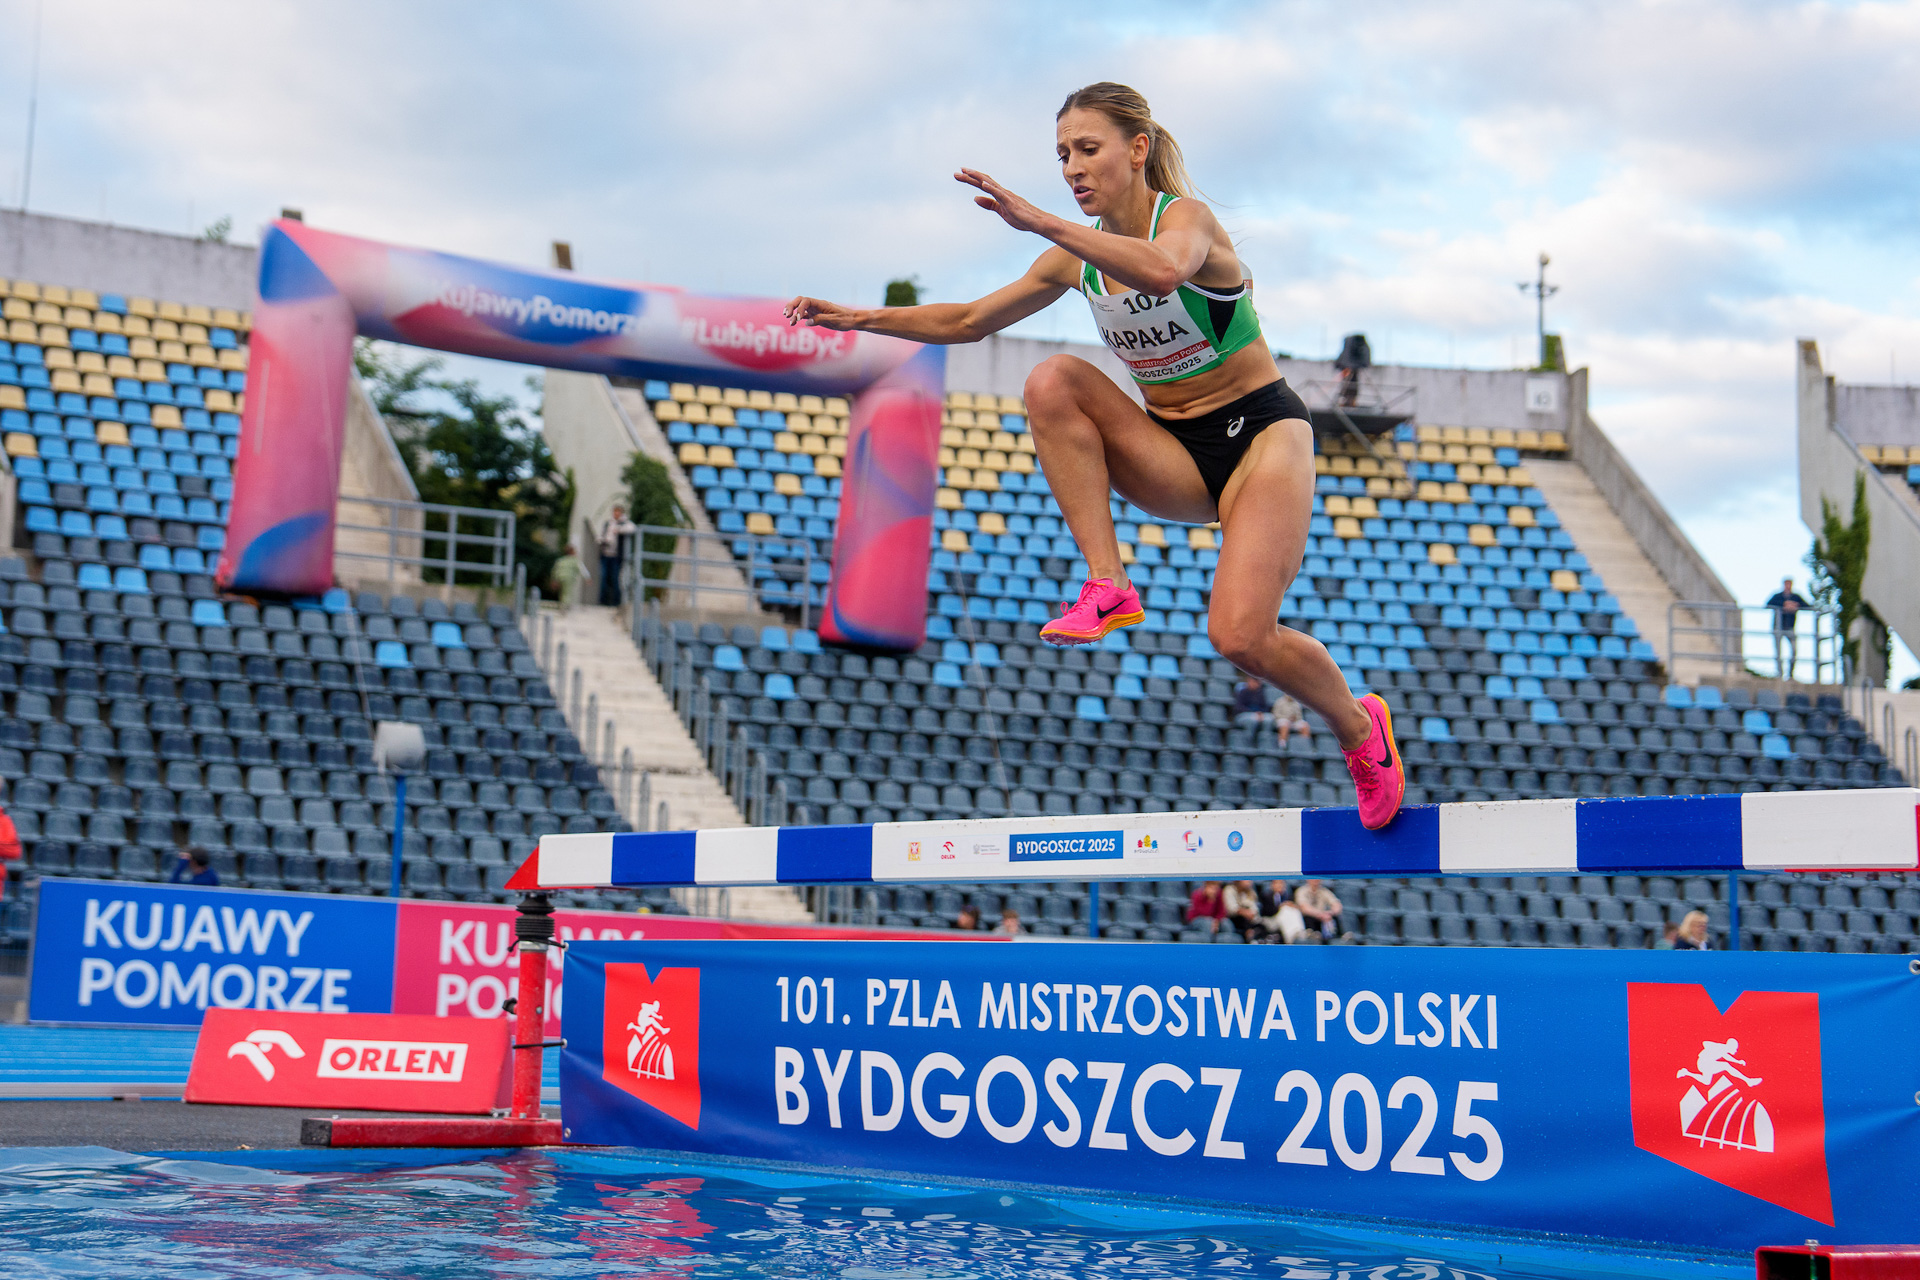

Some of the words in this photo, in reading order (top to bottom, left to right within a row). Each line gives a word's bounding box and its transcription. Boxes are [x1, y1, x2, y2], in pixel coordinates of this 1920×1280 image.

[1101, 320, 1190, 349] KAPAŁA
[1137, 354, 1180, 368] Mistrzostwa
[1180, 342, 1205, 358] Polski
[1175, 355, 1202, 372] 2025
[1016, 840, 1085, 855] BYDGOSZCZ
[1088, 838, 1116, 853] 2025
[83, 899, 314, 957] KUJAWY
[78, 957, 352, 1013] POMORZE
[775, 976, 851, 1025] 101.
[867, 978, 962, 1029] PZLA
[979, 982, 1297, 1041] MISTRZOSTWA
[1315, 990, 1499, 1050] POLSKI
[329, 1046, 458, 1075] ORLEN
[774, 1046, 1246, 1161] BYDGOSZCZ
[1274, 1069, 1505, 1182] 2025
